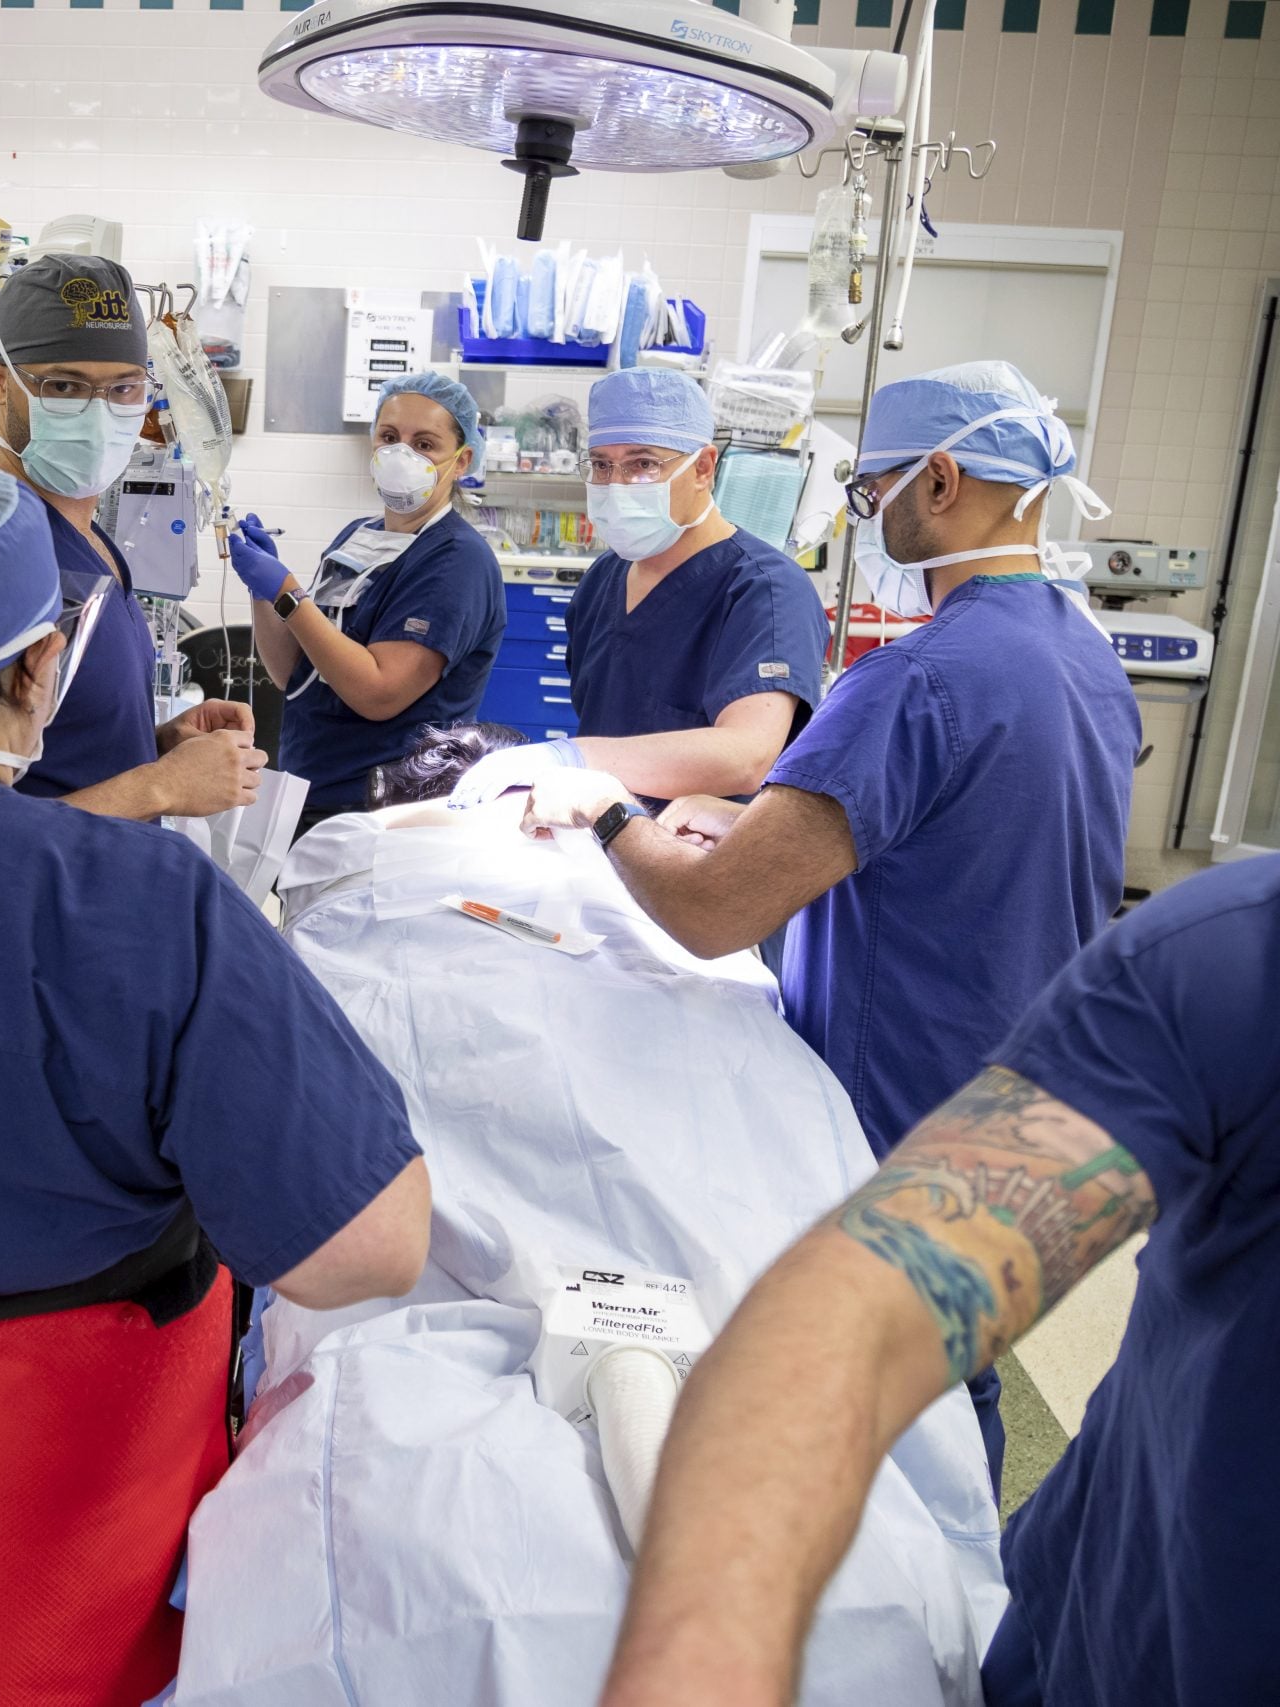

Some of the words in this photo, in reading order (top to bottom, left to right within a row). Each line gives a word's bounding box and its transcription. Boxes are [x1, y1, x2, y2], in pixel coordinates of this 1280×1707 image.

[688, 28, 752, 54] SKYTRON
[196, 648, 265, 669] Observ
[662, 1283, 687, 1294] 442
[592, 1317, 664, 1334] FilteredFlo
[583, 1326, 615, 1336] LOWER
[615, 1330, 639, 1339] BODY
[641, 1333, 681, 1343] BLANKET
